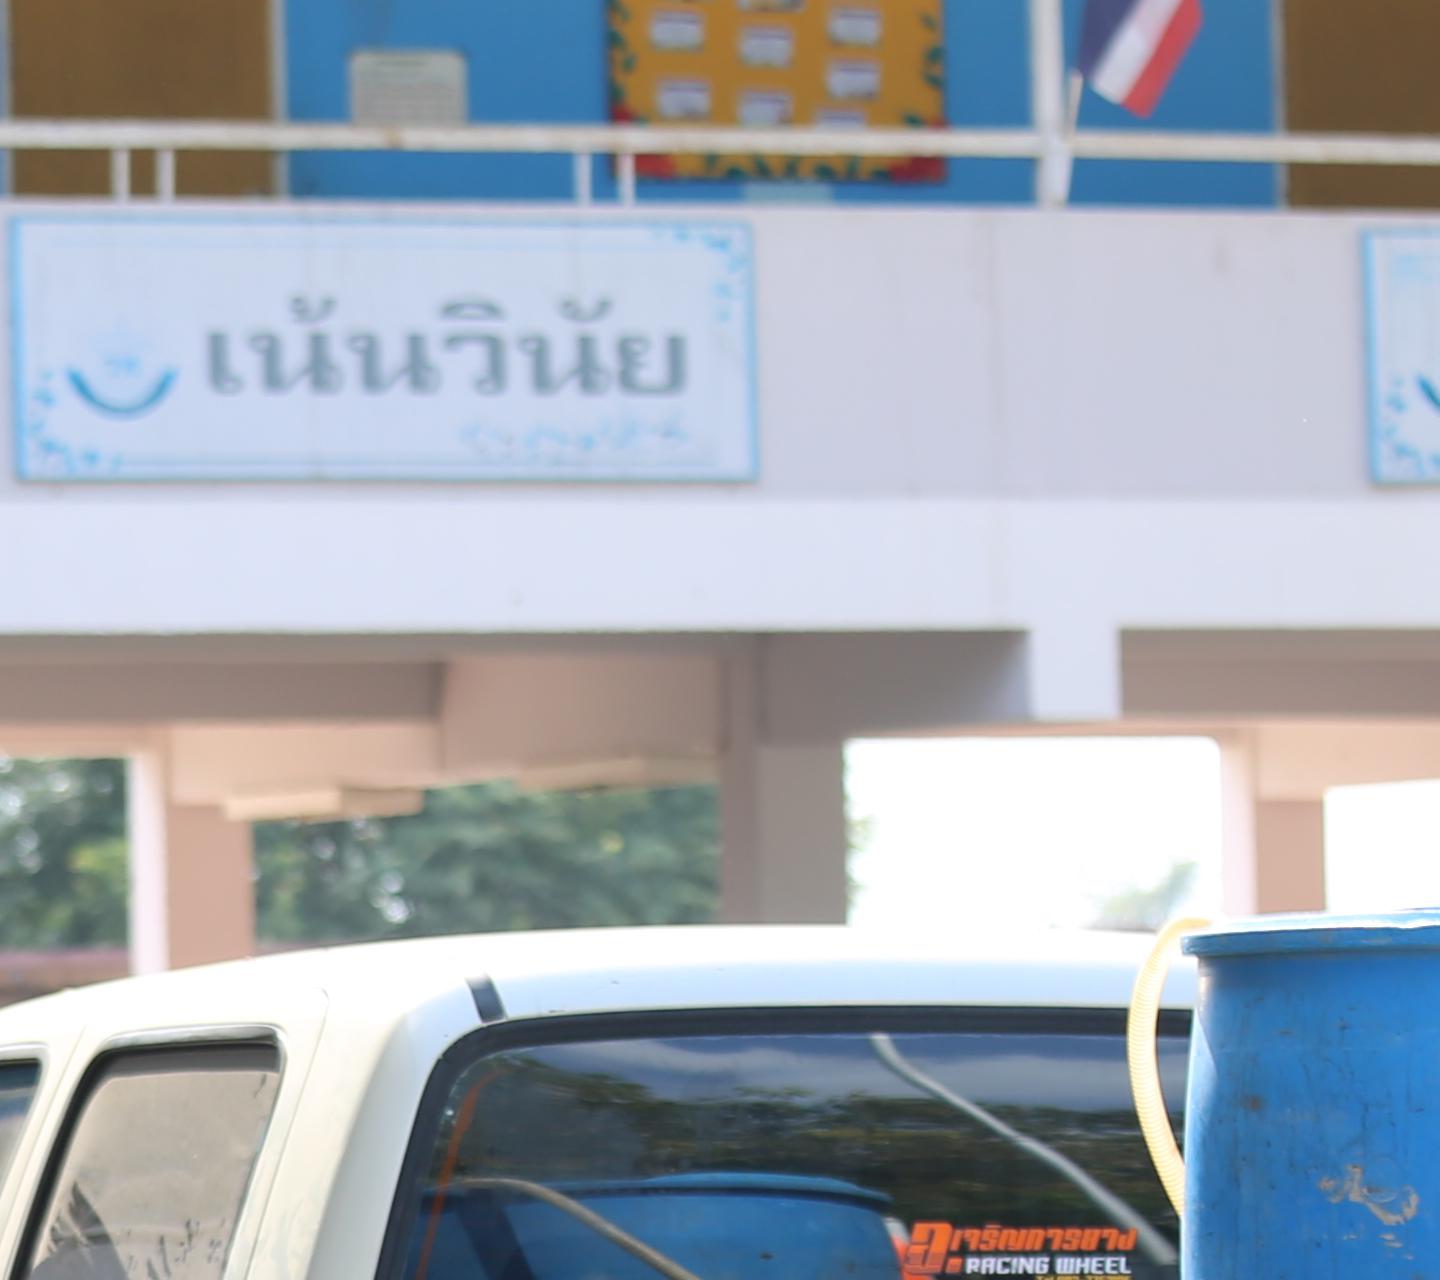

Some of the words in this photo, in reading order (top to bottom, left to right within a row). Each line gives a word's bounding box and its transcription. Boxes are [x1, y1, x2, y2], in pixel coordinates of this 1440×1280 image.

[203, 294, 691, 398] เน้นวินัย
[966, 1256, 1050, 1275] RACING
[1055, 1256, 1132, 1275] WHEEL
